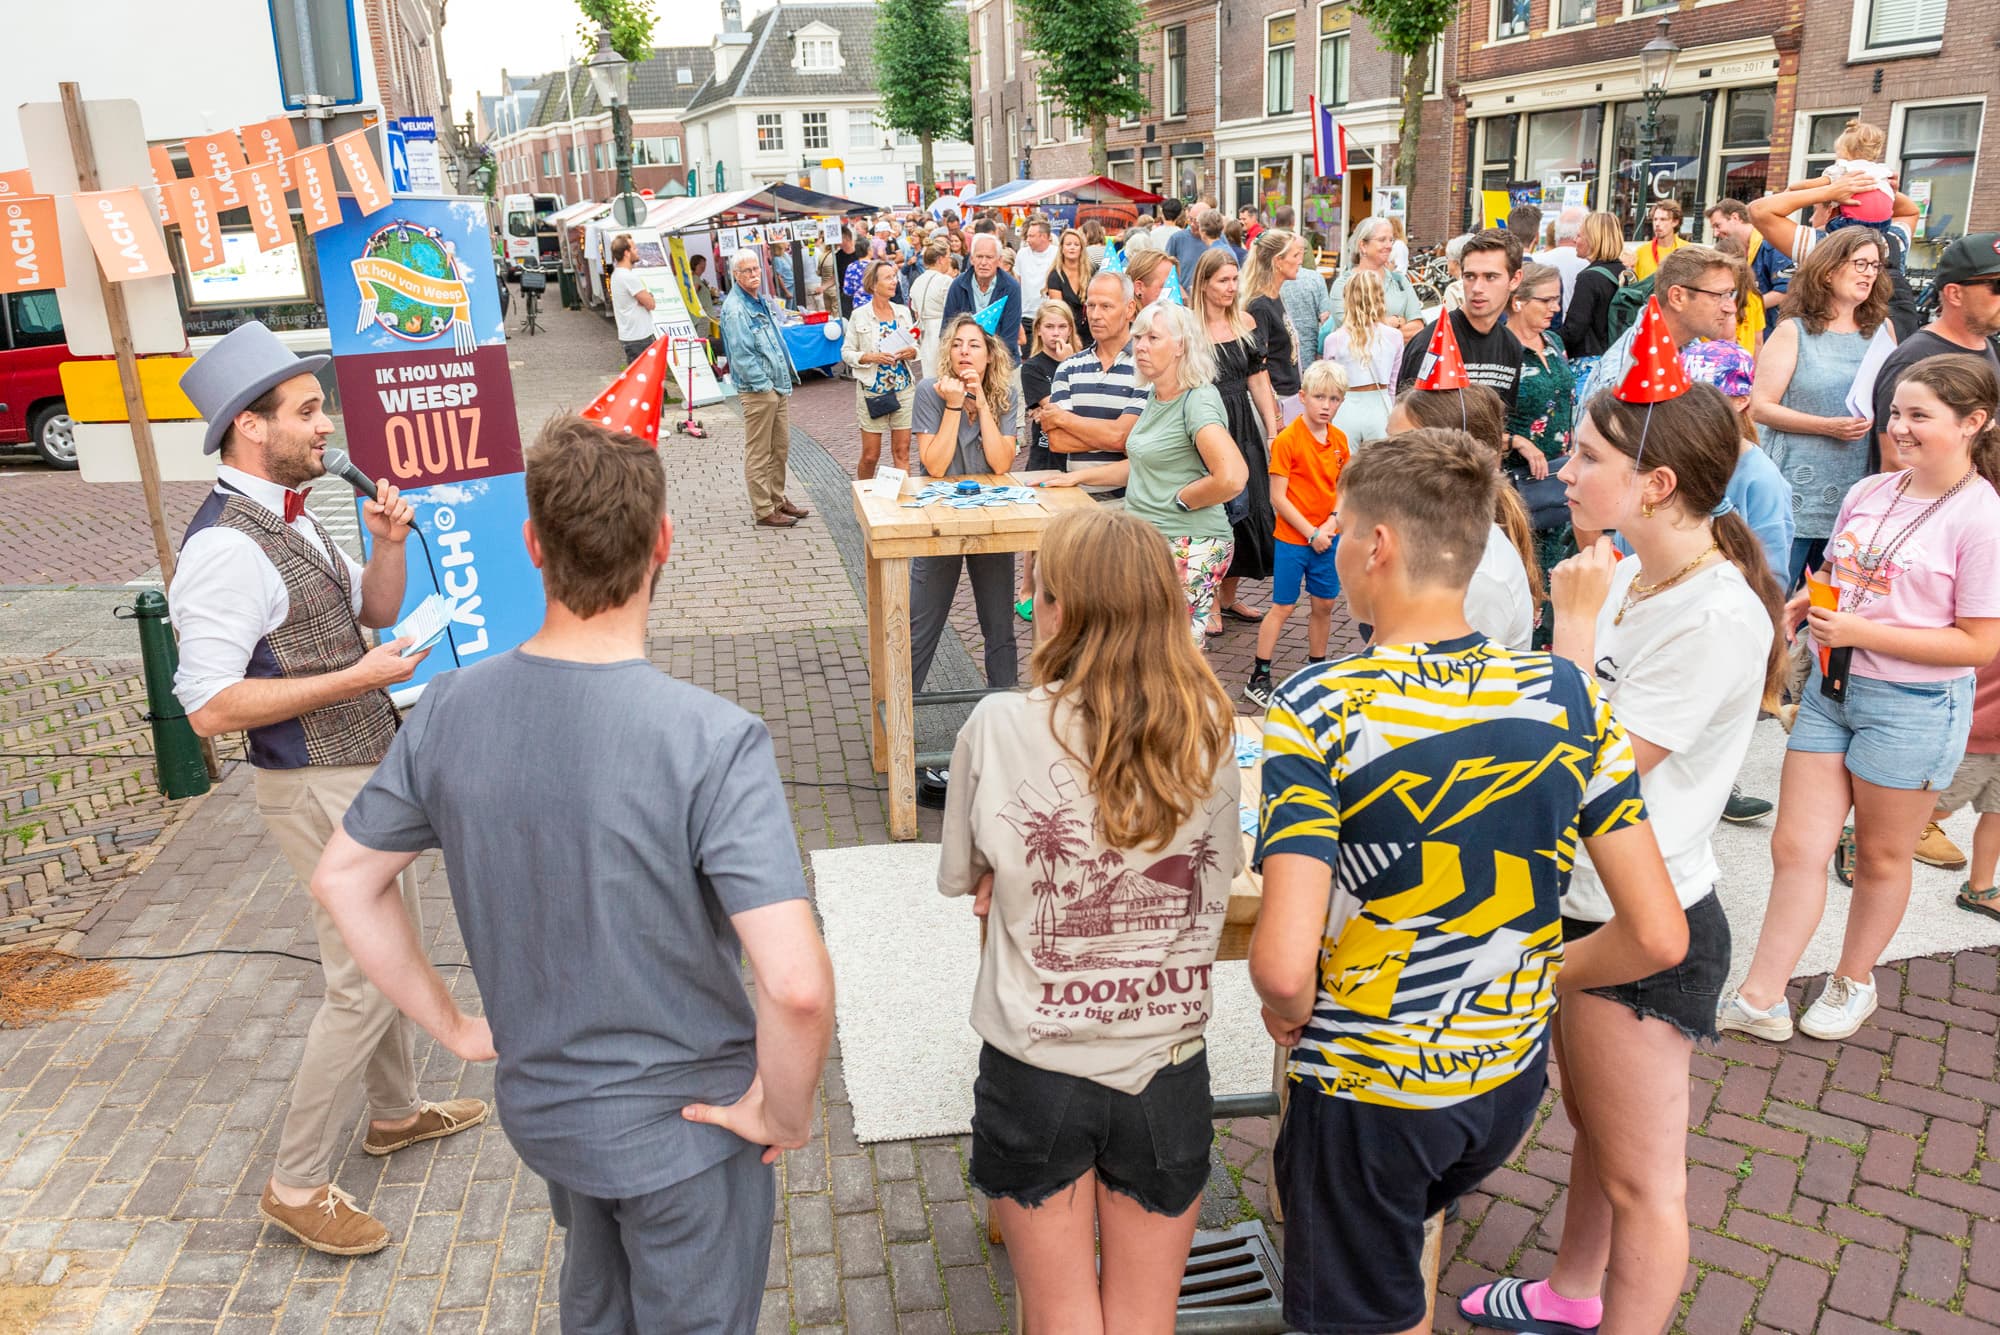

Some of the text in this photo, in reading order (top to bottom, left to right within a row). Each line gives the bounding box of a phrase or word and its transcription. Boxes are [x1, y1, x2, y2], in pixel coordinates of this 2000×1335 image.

[1744, 61, 1765, 72] 2017
[401, 121, 434, 131] WELKOM
[357, 262, 463, 302] Ik hou van Weesp
[186, 319, 241, 331] AKELAARS
[375, 361, 475, 385] IK HOU VAN
[378, 382, 478, 414] WEESP
[385, 407, 490, 479] QUIZ
[1084, 1006, 1115, 1024] big
[1118, 1007, 1144, 1022] day
[1147, 1001, 1177, 1017] for
[1182, 1000, 1202, 1016] yo
